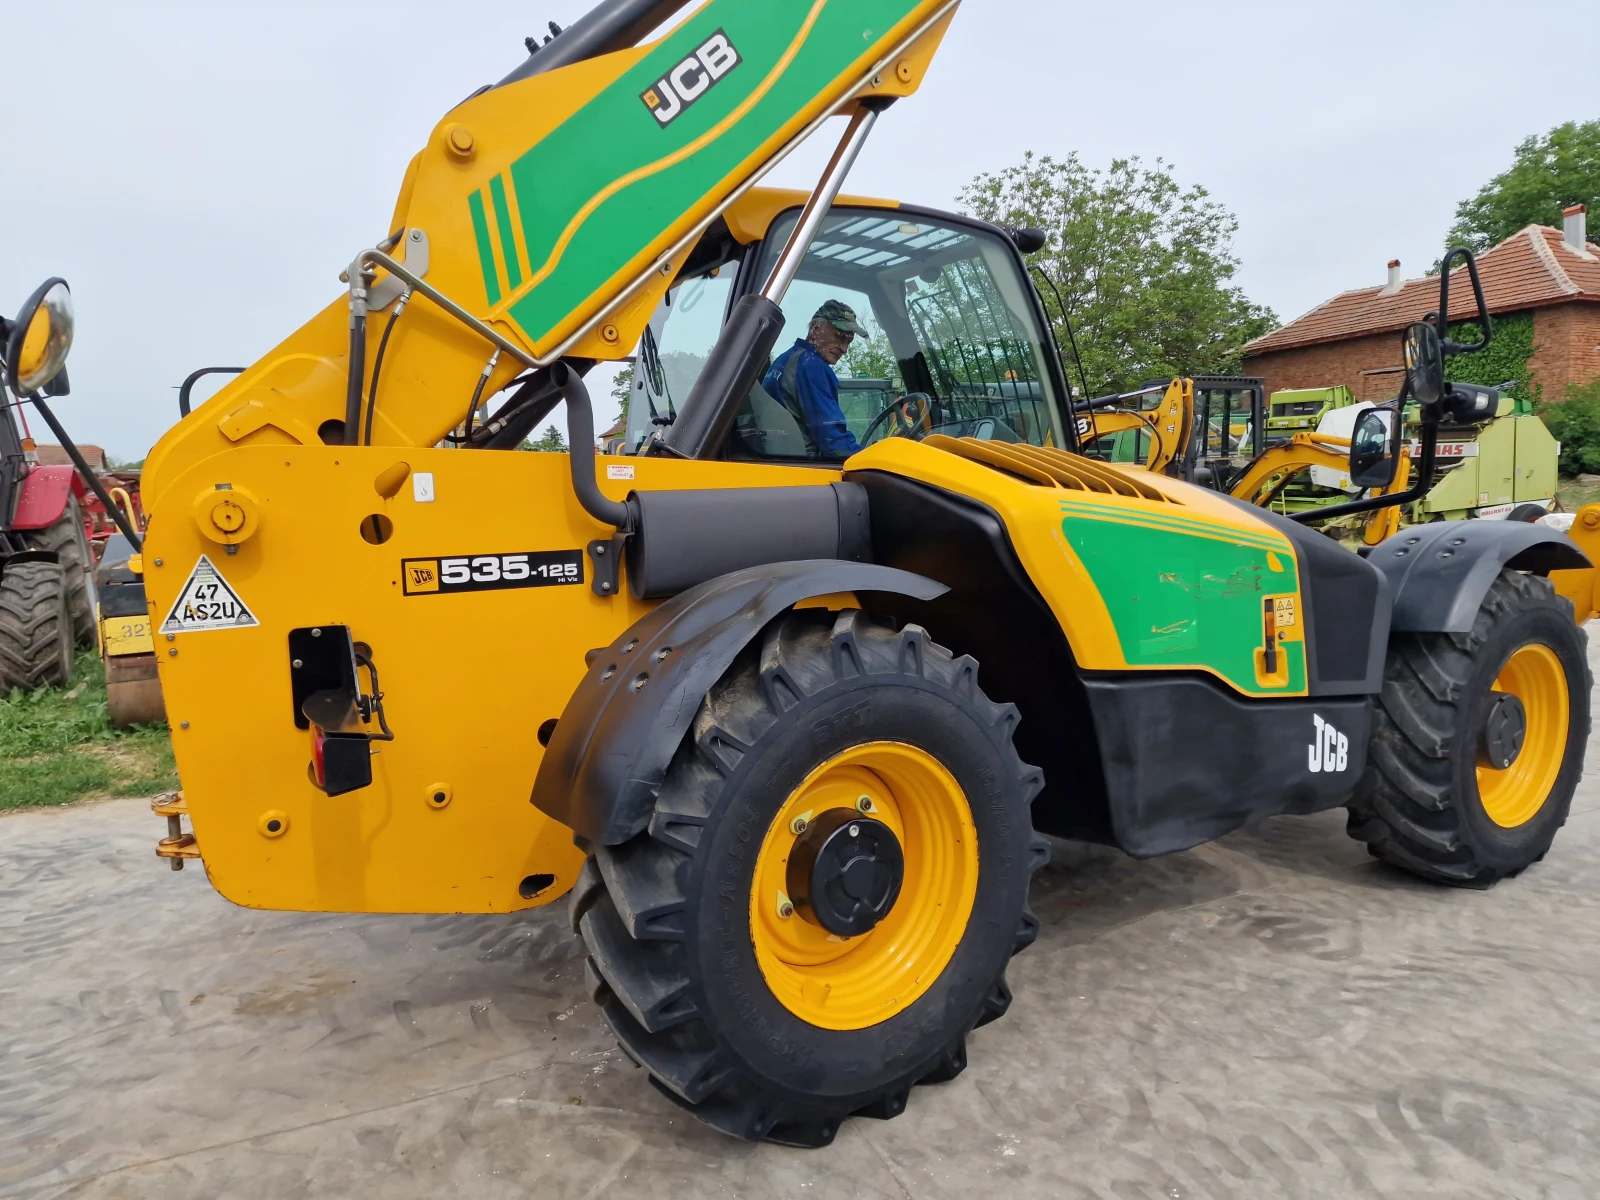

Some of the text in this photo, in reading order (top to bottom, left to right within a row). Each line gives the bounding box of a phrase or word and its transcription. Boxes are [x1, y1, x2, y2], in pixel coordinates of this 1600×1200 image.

[653, 34, 738, 123] JCB
[412, 555, 578, 586] JCB 535-125
[195, 584, 219, 602] 47
[183, 602, 236, 622] AS2U
[1308, 713, 1349, 773] JCB
